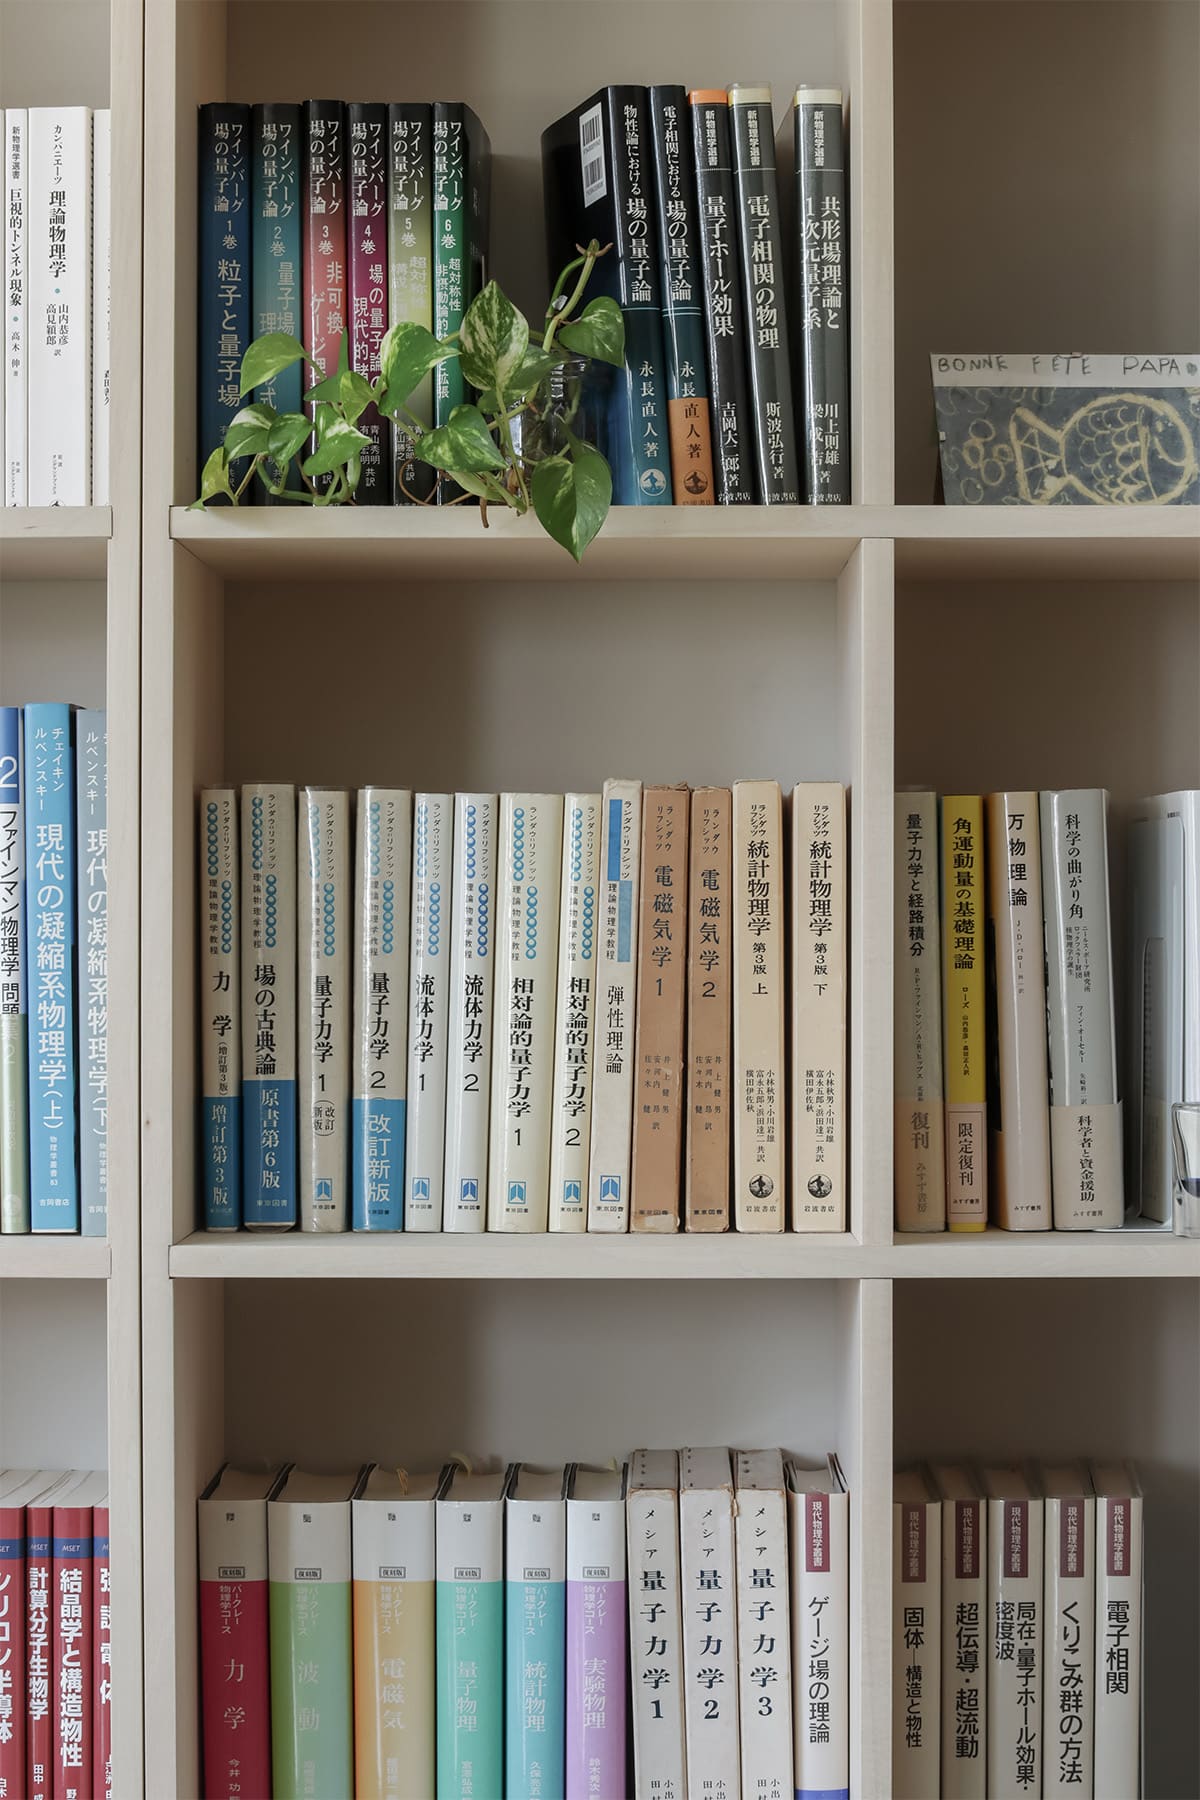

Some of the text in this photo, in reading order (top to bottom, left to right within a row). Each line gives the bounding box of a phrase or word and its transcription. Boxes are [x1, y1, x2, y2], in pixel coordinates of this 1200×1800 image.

[214, 122, 230, 213] 場の量子論
[231, 124, 245, 214] ワインバーグ
[262, 123, 278, 218] 場の量子論
[278, 124, 294, 218] ワインバーグ
[309, 120, 326, 214] 場の量子論
[327, 120, 342, 215] ワインバーグ
[352, 122, 368, 217] 場の量子論
[368, 123, 385, 218] ワインバーグ
[393, 121, 408, 211] 場の量子論
[410, 121, 425, 212] ワインバーグ
[433, 121, 449, 211] 場の量子論
[449, 121, 463, 212] ワインバーグ
[623, 104, 641, 195] 物性論における
[663, 105, 681, 198] 電子相関における
[10, 188, 23, 306] 巨視的トンネル現象
[49, 190, 66, 278] 理論物理学
[222, 219, 238, 250] 1巻
[270, 226, 286, 257] 2巻
[318, 225, 334, 255] 3巻
[361, 225, 376, 255] 4巻
[401, 218, 417, 248] 5巻
[441, 219, 457, 249] 6巻
[626, 198, 652, 301] 場の量子論
[666, 200, 693, 301] 場の量子論
[705, 196, 735, 337] 量子ホール効果
[747, 195, 780, 349] 電子相関の物理
[801, 197, 821, 330] 1次元量子系
[821, 196, 842, 329] 共形場理論と
[217, 258, 242, 407] 粒子と量子場
[326, 261, 343, 334] 非可換
[937, 355, 1008, 372] BONNE
[1123, 356, 1180, 375] PAPA
[0, 755, 18, 788] 2
[35, 727, 48, 811] ルベンスキー
[52, 727, 65, 792] チェイキン
[87, 731, 98, 816] ルベンスキー
[664, 805, 674, 851] ランダウ
[712, 809, 720, 854] ランダウ
[758, 805, 766, 836] ランダウ
[821, 805, 829, 837] ランダウ
[1008, 813, 1028, 907] 万物理論
[1065, 813, 1083, 919] 科学の曲がり角
[1, 810, 19, 977] ファインマン物理学
[652, 866, 674, 997] 電磁気学 1
[747, 840, 770, 995] 統計物理学 第3版 上
[809, 840, 832, 996] 統計物理学 第3版 下
[906, 813, 925, 957] 量子力学と経路積分
[952, 817, 976, 970] 角運動量の基礎理論
[700, 869, 720, 998] 電磁気学 2
[254, 964, 276, 1076] 場の古典論
[314, 975, 333, 1092] 量子力学 1
[370, 972, 390, 1089] 量子力学 2
[414, 974, 435, 1091] 流体力学 1
[464, 974, 484, 1092] 流体力学 2
[508, 977, 534, 1146] 相対論的量子力学 1
[563, 977, 590, 1146] 相対論的量子力学 2
[606, 985, 624, 1074] 弾性理論
[211, 1104, 228, 1206] 増訂第3版
[261, 1088, 281, 1189] 原書第6版
[367, 1113, 391, 1203] 改訂新版
[910, 1111, 931, 1150] 復刊
[958, 1122, 974, 1186] 限定復刊
[1077, 1114, 1095, 1202] 科学者と資金援助
[645, 1509, 658, 1559] メシア
[702, 1509, 714, 1558] メシア
[755, 1507, 767, 1556] メシア
[29, 1567, 49, 1720] 計算分子生物学
[60, 1568, 83, 1767] 結晶学と構造物性
[808, 1596, 830, 1743] ゲージ場の理論
[995, 1601, 1015, 1660] 密度波
[1106, 1600, 1130, 1694] 電子相関
[382, 1658, 405, 1730] 電磁気
[456, 1660, 478, 1732] 量子物理
[524, 1660, 547, 1732] 統計物理
[583, 1657, 607, 1729] 実験物理
[955, 1603, 979, 1759] 超伝導・超流動
[1059, 1601, 1083, 1784] くりこみ群の方法
